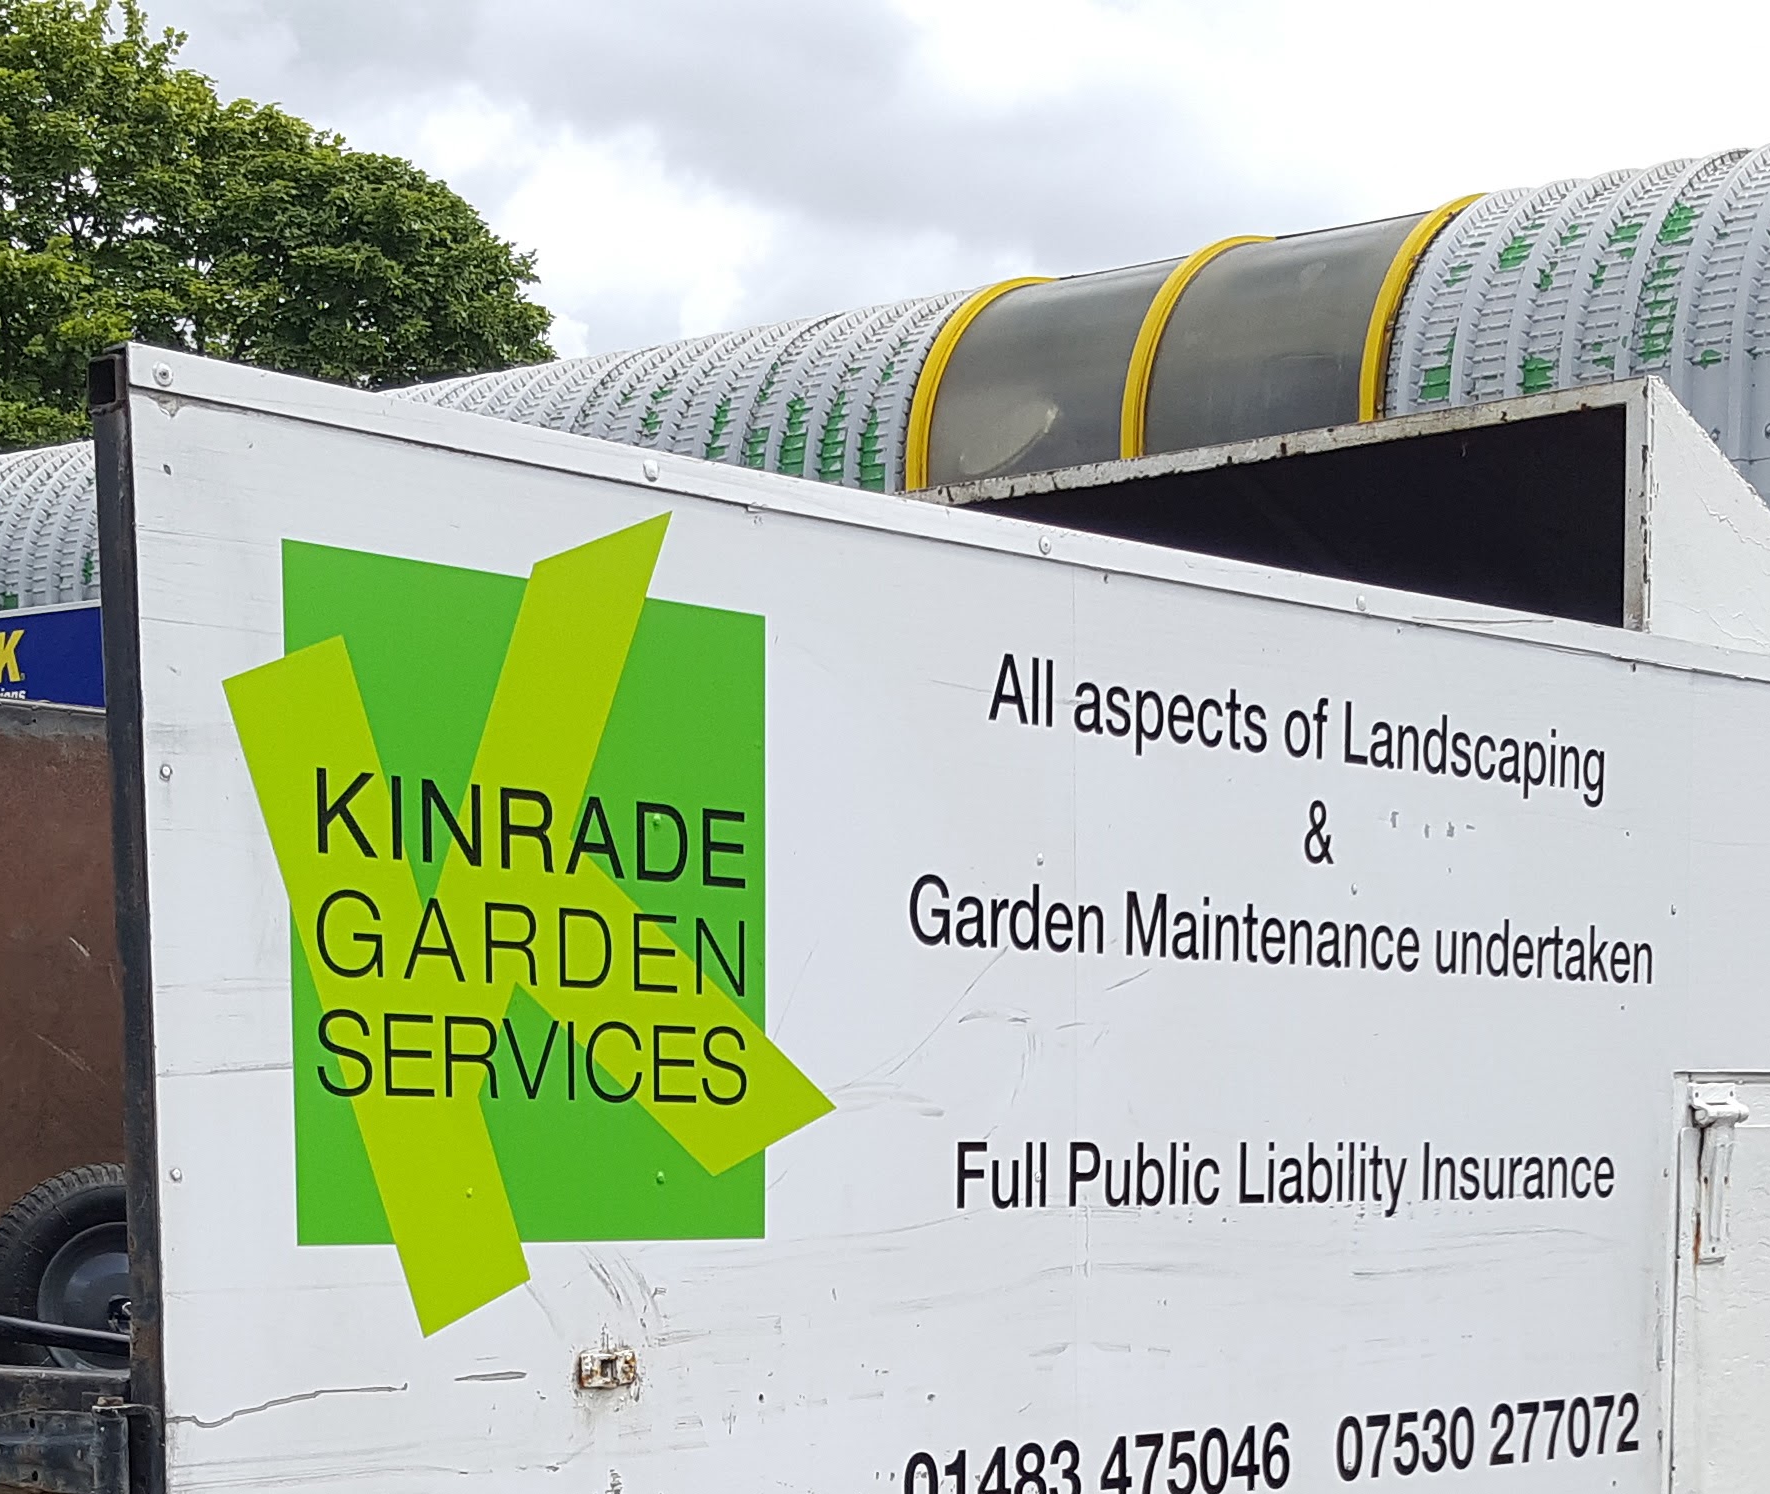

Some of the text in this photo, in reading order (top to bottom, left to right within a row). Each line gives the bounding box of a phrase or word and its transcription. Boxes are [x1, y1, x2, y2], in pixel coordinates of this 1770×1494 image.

[989, 654, 1604, 807] All aspects of Landscaping
[317, 768, 745, 888] KINRADE
[1305, 800, 1333, 864] &
[317, 890, 744, 996] GARDEN
[910, 875, 1652, 983] Garden Maintenance undertaken
[318, 1009, 746, 1105] SERVICES
[958, 1142, 1614, 1217] Full Public Liability Insurance
[1338, 1407, 1473, 1481] 07530
[1491, 1393, 1638, 1465] 277072
